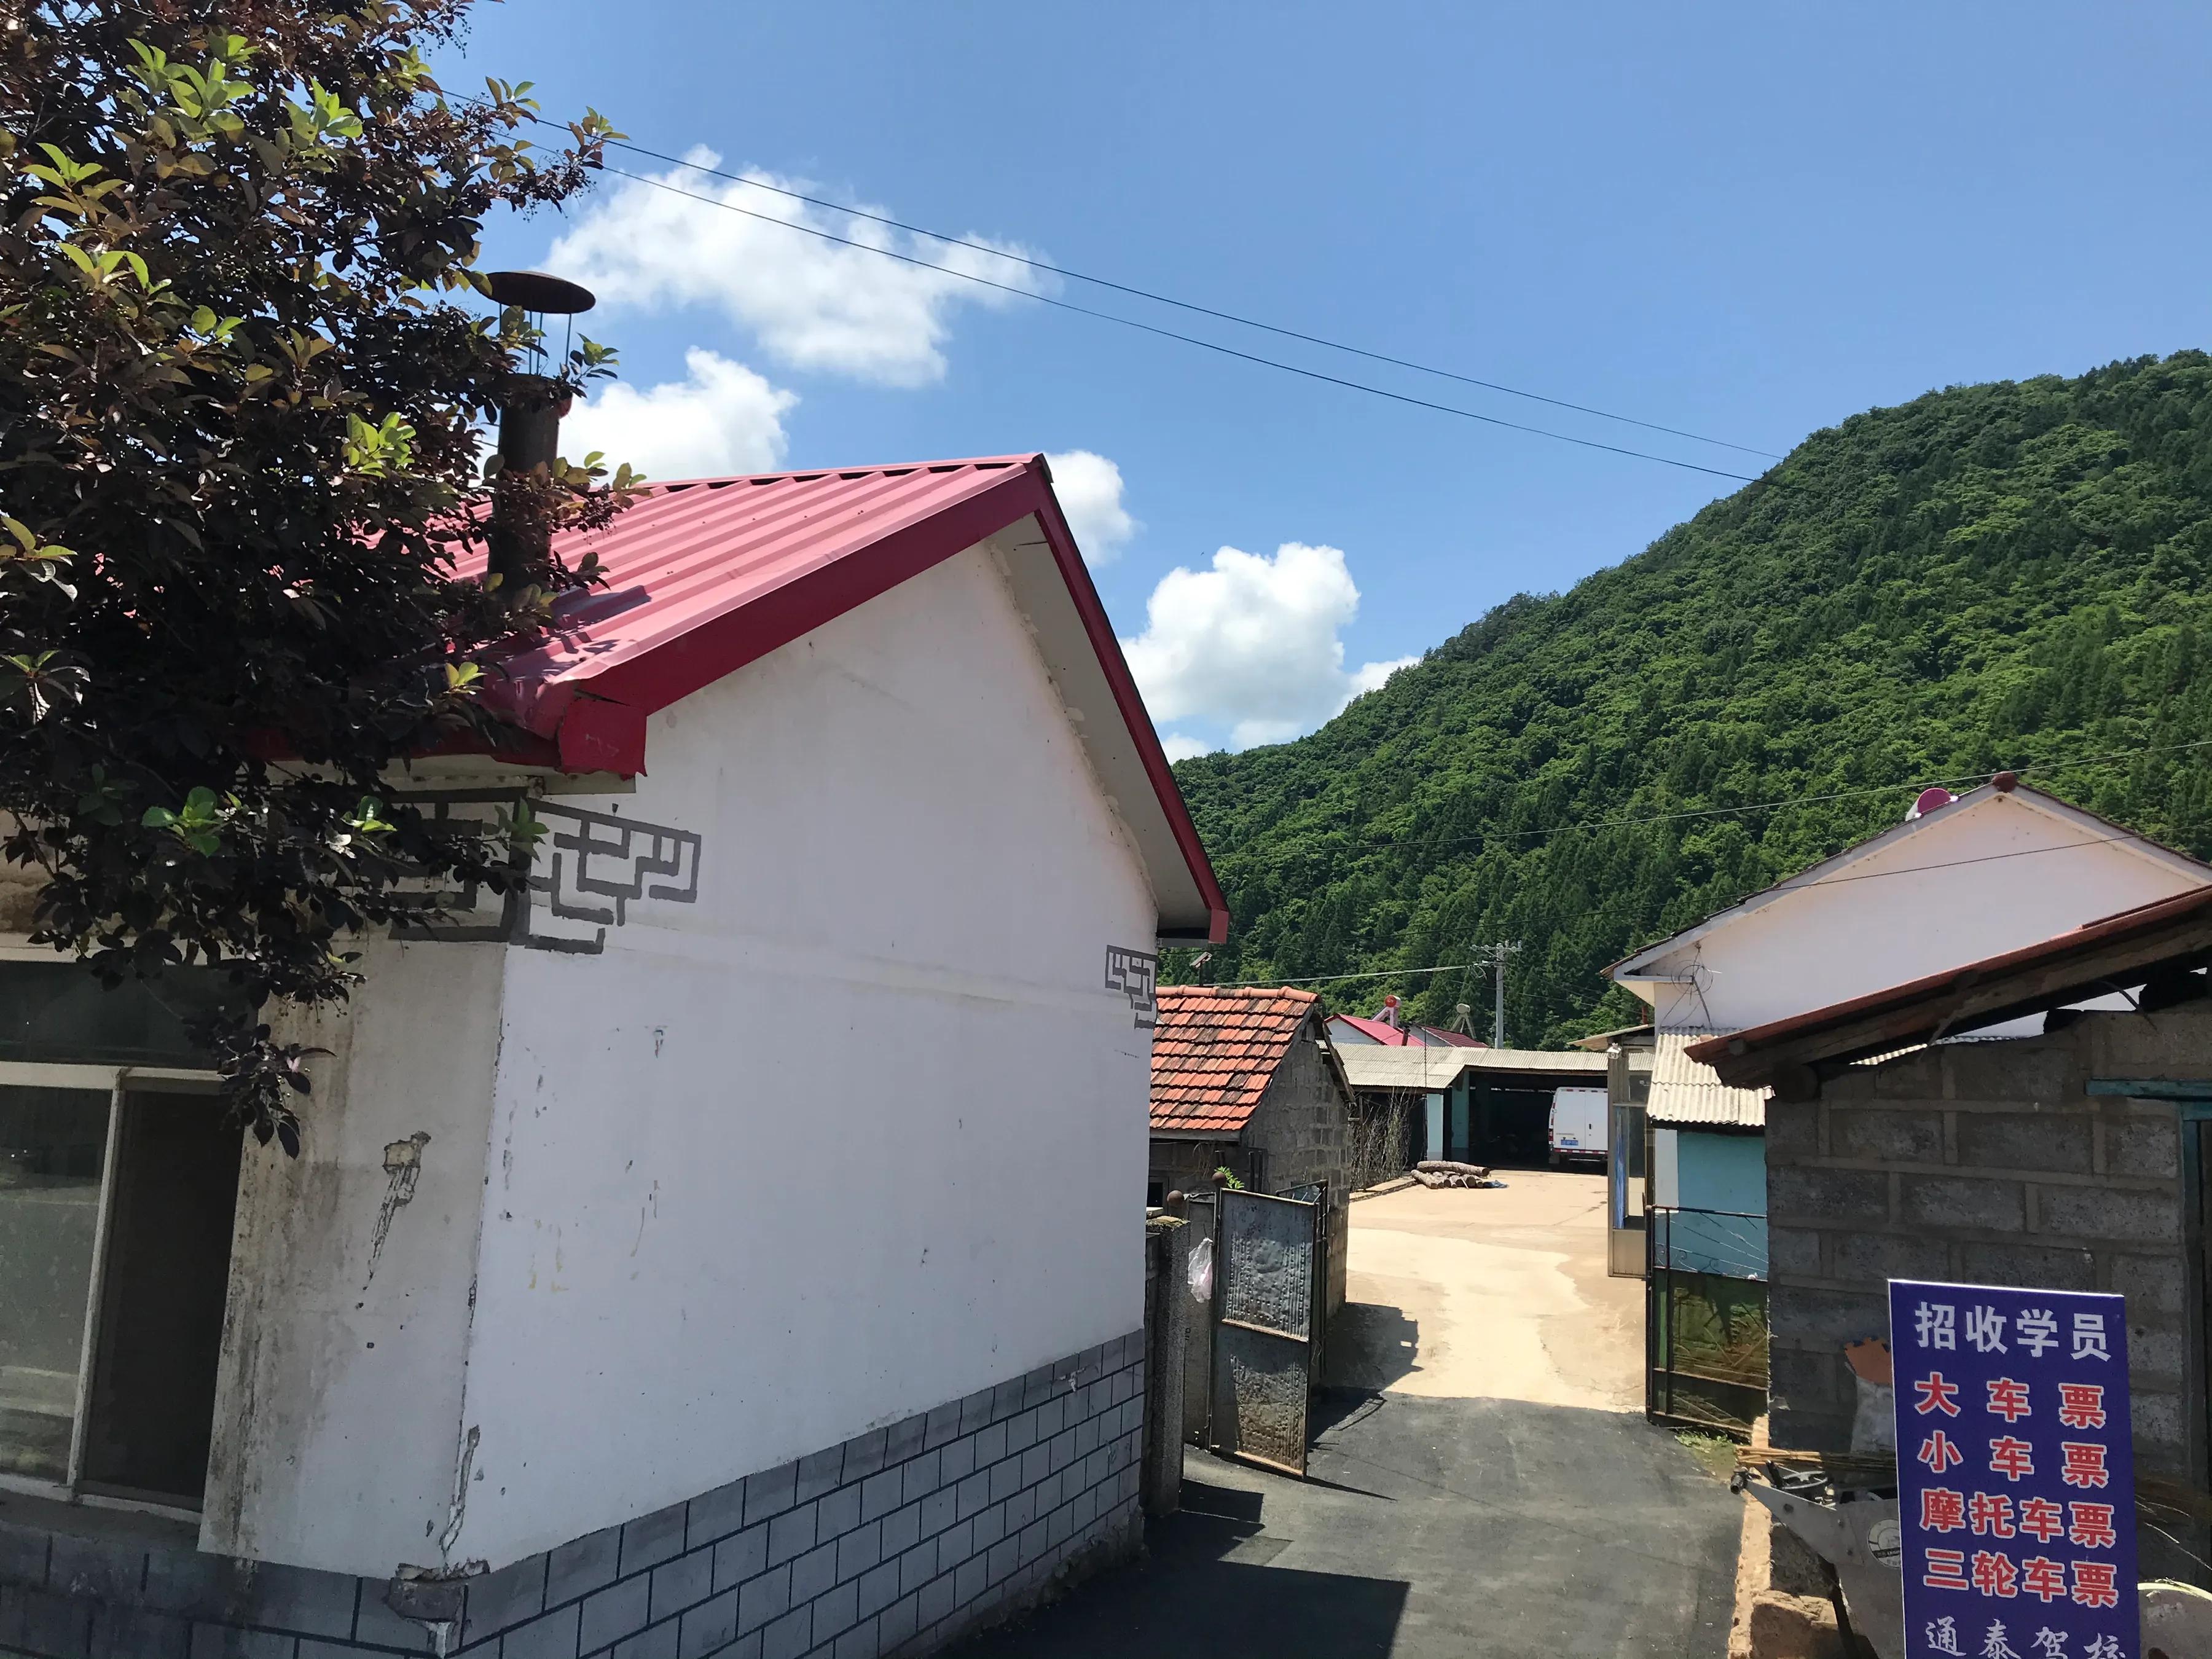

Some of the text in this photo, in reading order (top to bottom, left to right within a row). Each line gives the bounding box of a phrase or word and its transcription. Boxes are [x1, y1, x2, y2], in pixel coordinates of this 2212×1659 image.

[1915, 1301, 2112, 1362] 招收学员
[1914, 1371, 2106, 1429] 大车票
[1918, 1430, 2109, 1489] 小车票
[1920, 1488, 2117, 1548] 摩托车票
[1923, 1548, 2119, 1608] 三轮车票
